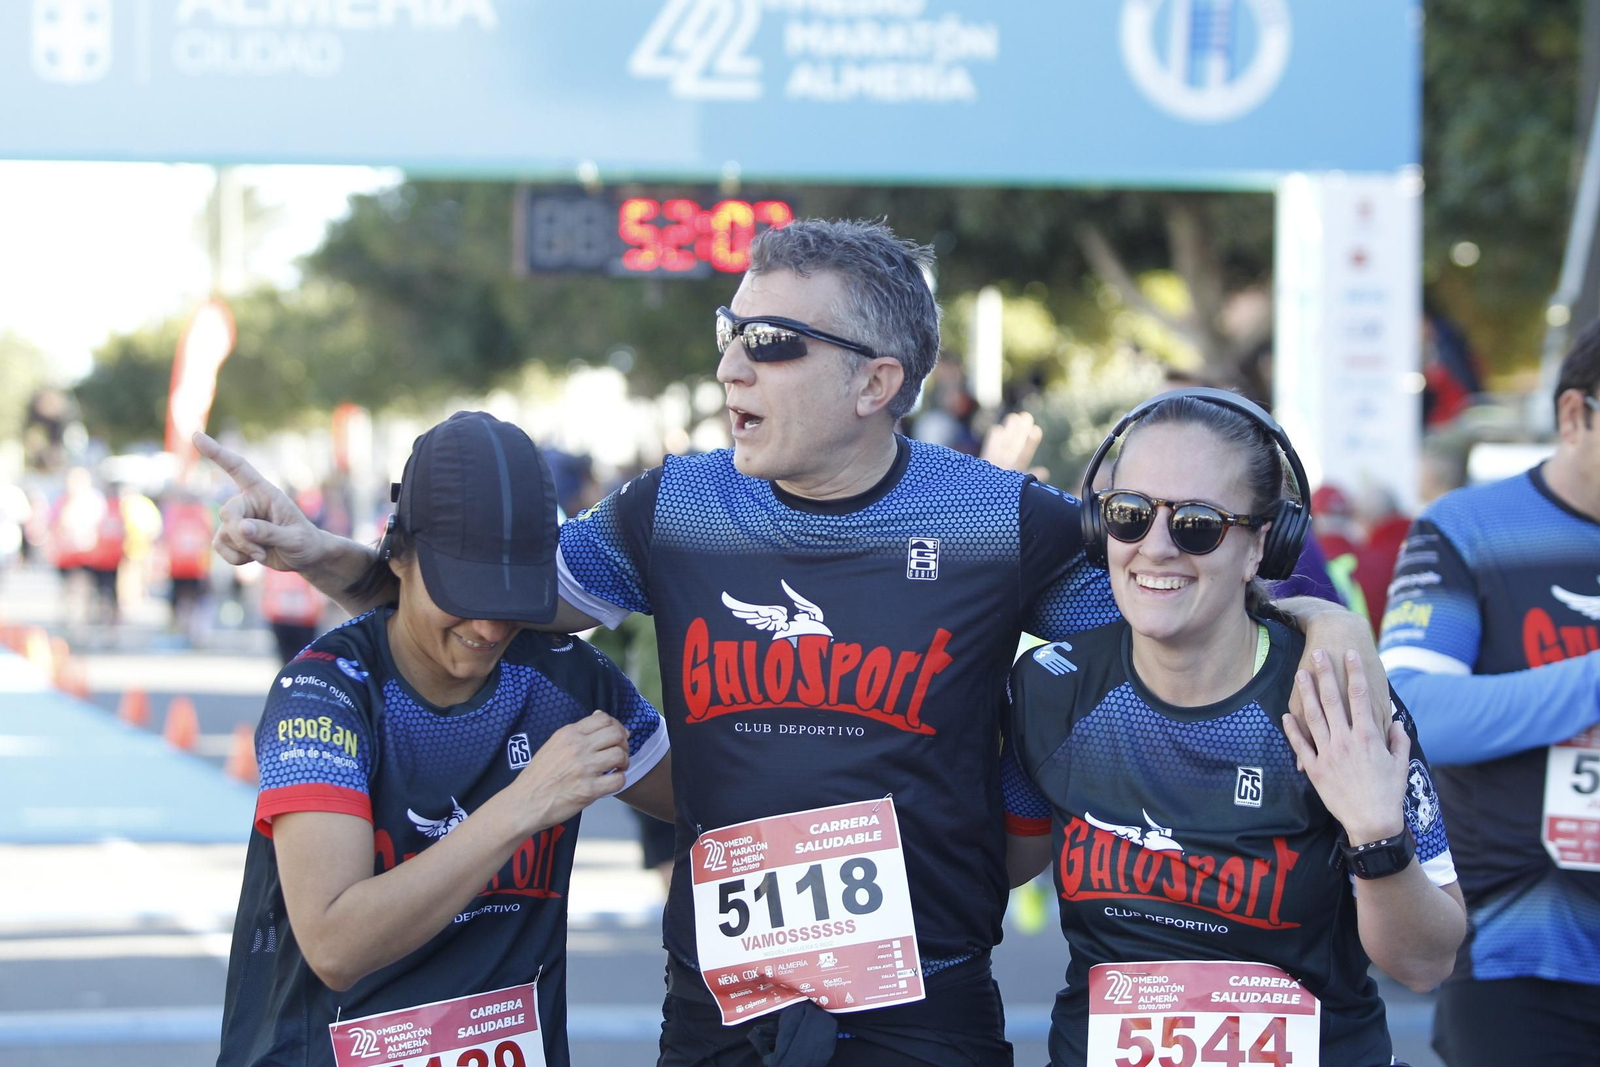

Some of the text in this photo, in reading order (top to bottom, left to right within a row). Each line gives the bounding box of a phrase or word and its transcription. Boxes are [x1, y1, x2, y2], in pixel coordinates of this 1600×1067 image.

[784, 13, 998, 59] MARATÓN
[172, 28, 345, 76] CIUDAD
[295, 674, 327, 689] óptica
[734, 722, 865, 737] CLUB DEPORTIVO
[280, 747, 305, 762] centro
[307, 747, 320, 759] de
[809, 814, 880, 835] CARRERA
[729, 835, 753, 848] MEDIO
[730, 841, 768, 858] MARATÓN
[795, 830, 882, 854] SALUDABLE
[732, 852, 765, 868] ALMERÍA
[718, 857, 884, 938] 5118
[454, 903, 520, 923] DEPORTIVO
[741, 919, 857, 952] VAMOSSSSSS
[763, 949, 785, 957] MIGUEL
[787, 943, 819, 954] HIGUERAS
[778, 960, 808, 971] ALMERÍA
[1138, 975, 1169, 984] MEDIO
[1229, 975, 1300, 990] CARRERA
[1138, 983, 1185, 994] MARATÓN
[744, 997, 767, 1009] cajamar
[1138, 993, 1178, 1004] ALMERÍA
[1210, 991, 1301, 1005] SALUDABLE
[470, 998, 523, 1020] CARRERA
[382, 1022, 414, 1036] MEDIO
[457, 1013, 525, 1039] SALUDABLE
[384, 1027, 432, 1044] MARATÓN
[1115, 1016, 1293, 1067] 5544
[386, 1036, 429, 1053] ALMERÍA
